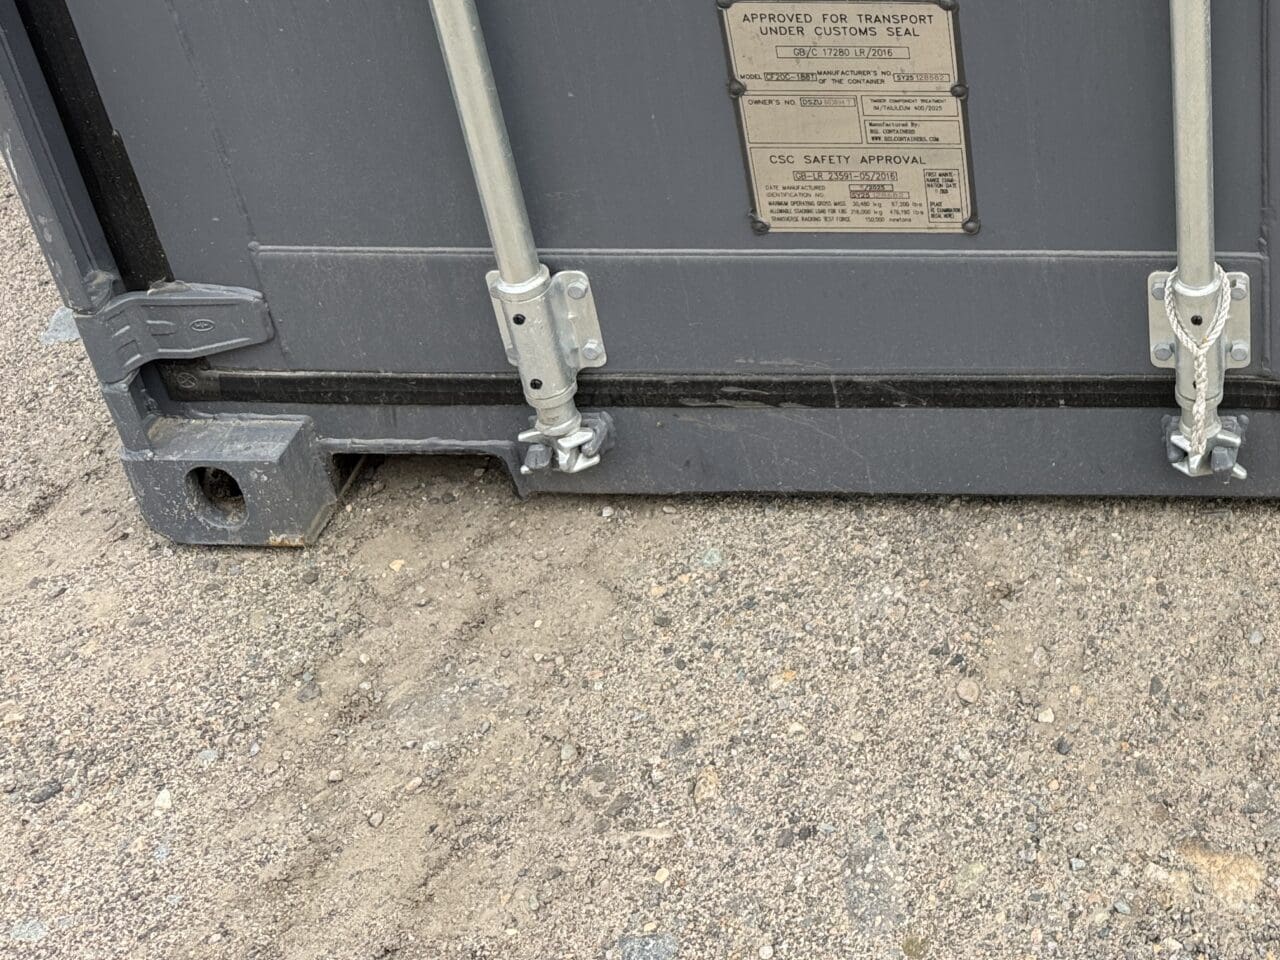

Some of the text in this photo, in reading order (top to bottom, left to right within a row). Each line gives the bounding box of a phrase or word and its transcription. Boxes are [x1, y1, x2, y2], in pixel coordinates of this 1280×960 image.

[742, 13, 935, 25] APPROVED FOR TRANSPORT
[759, 26, 921, 38] UNDER CUSTOMS SEAL
[793, 47, 818, 59] GB/C
[770, 155, 927, 165] CSC SAFETY APPROVAL
